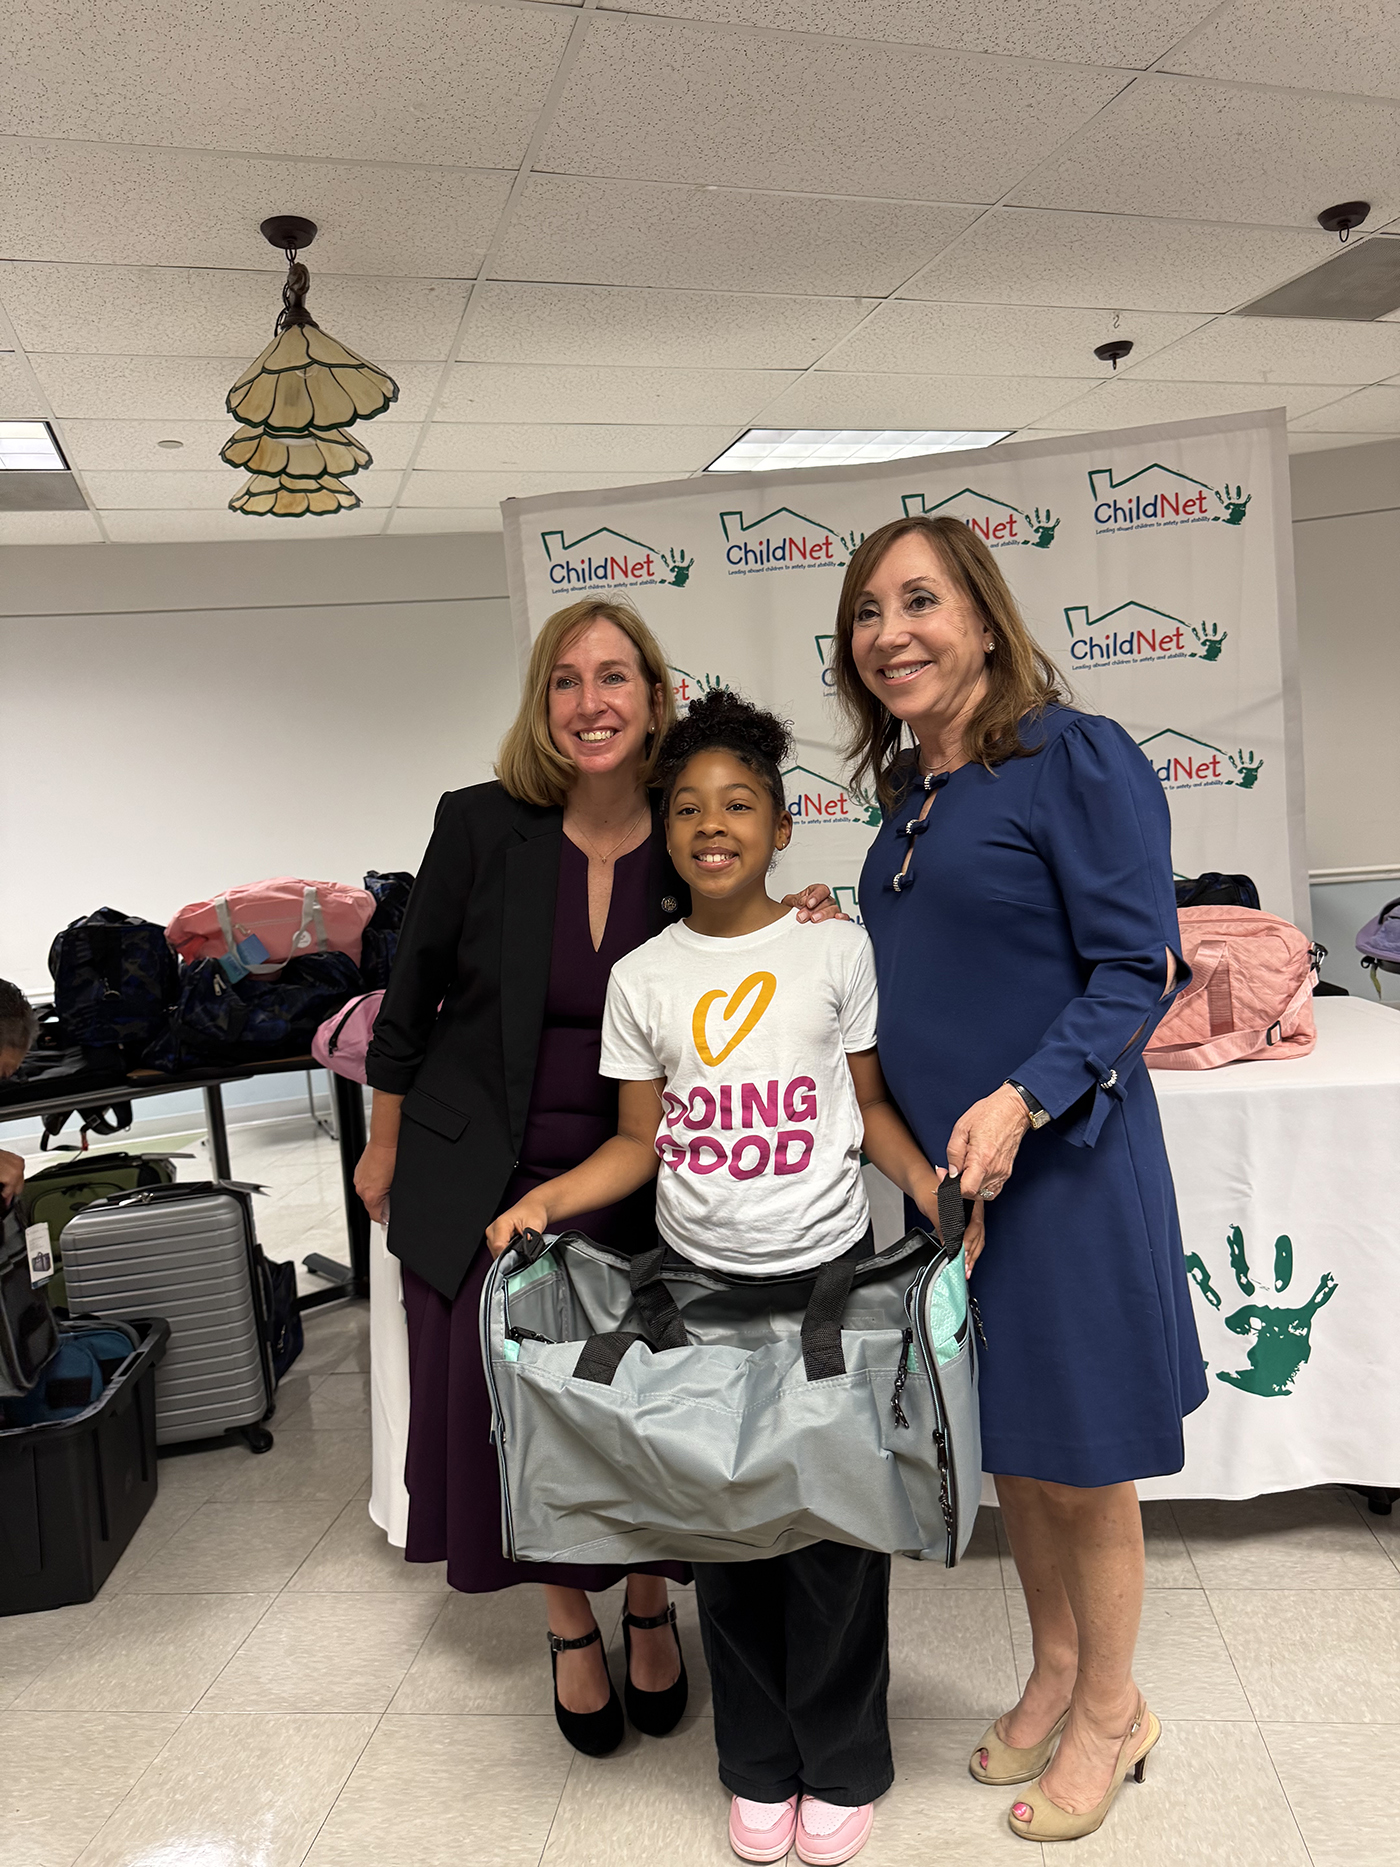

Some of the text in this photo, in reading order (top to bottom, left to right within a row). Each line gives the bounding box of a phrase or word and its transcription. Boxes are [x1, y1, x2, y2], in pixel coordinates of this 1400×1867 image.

[1094, 490, 1208, 524] ChildNet
[726, 535, 834, 566] ChildNet
[549, 554, 655, 584] ChildNet
[1070, 627, 1185, 660] ChildNet
[1111, 658, 1131, 666] children
[1150, 754, 1221, 782] dNet
[662, 1075, 817, 1130] DOING
[655, 1129, 814, 1181] GOOD
